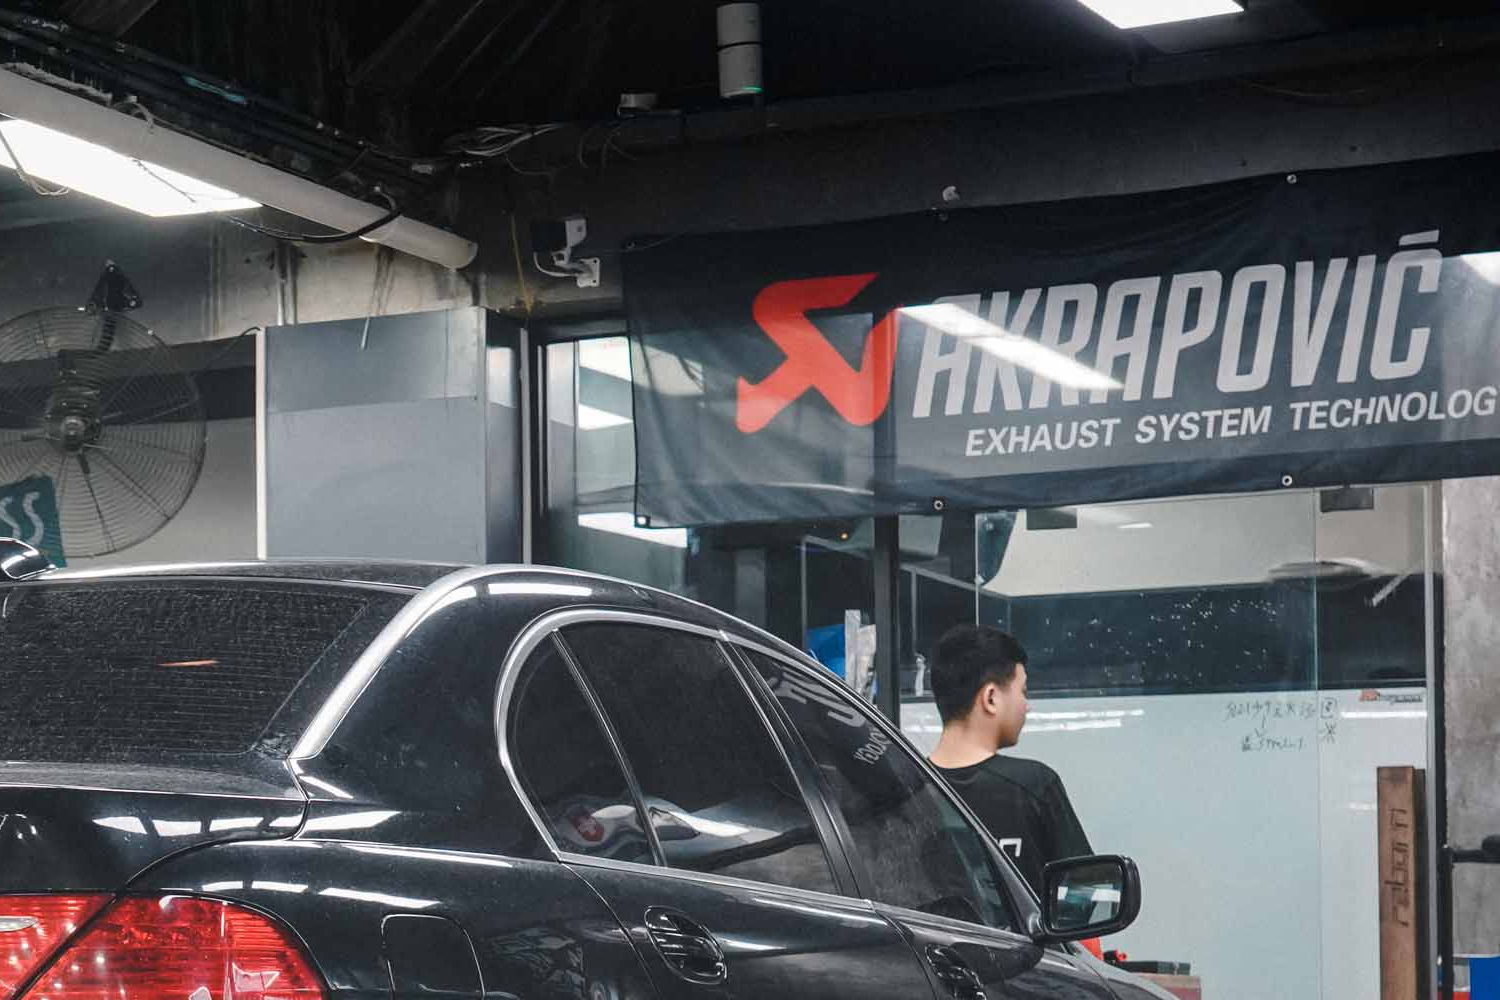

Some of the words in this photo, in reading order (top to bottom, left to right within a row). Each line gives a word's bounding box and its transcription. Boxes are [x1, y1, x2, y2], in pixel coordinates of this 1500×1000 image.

[965, 418, 1121, 457] EXHAUST
[1134, 405, 1272, 444] SYSTEM
[1289, 386, 1500, 431] TECHNOLOG
